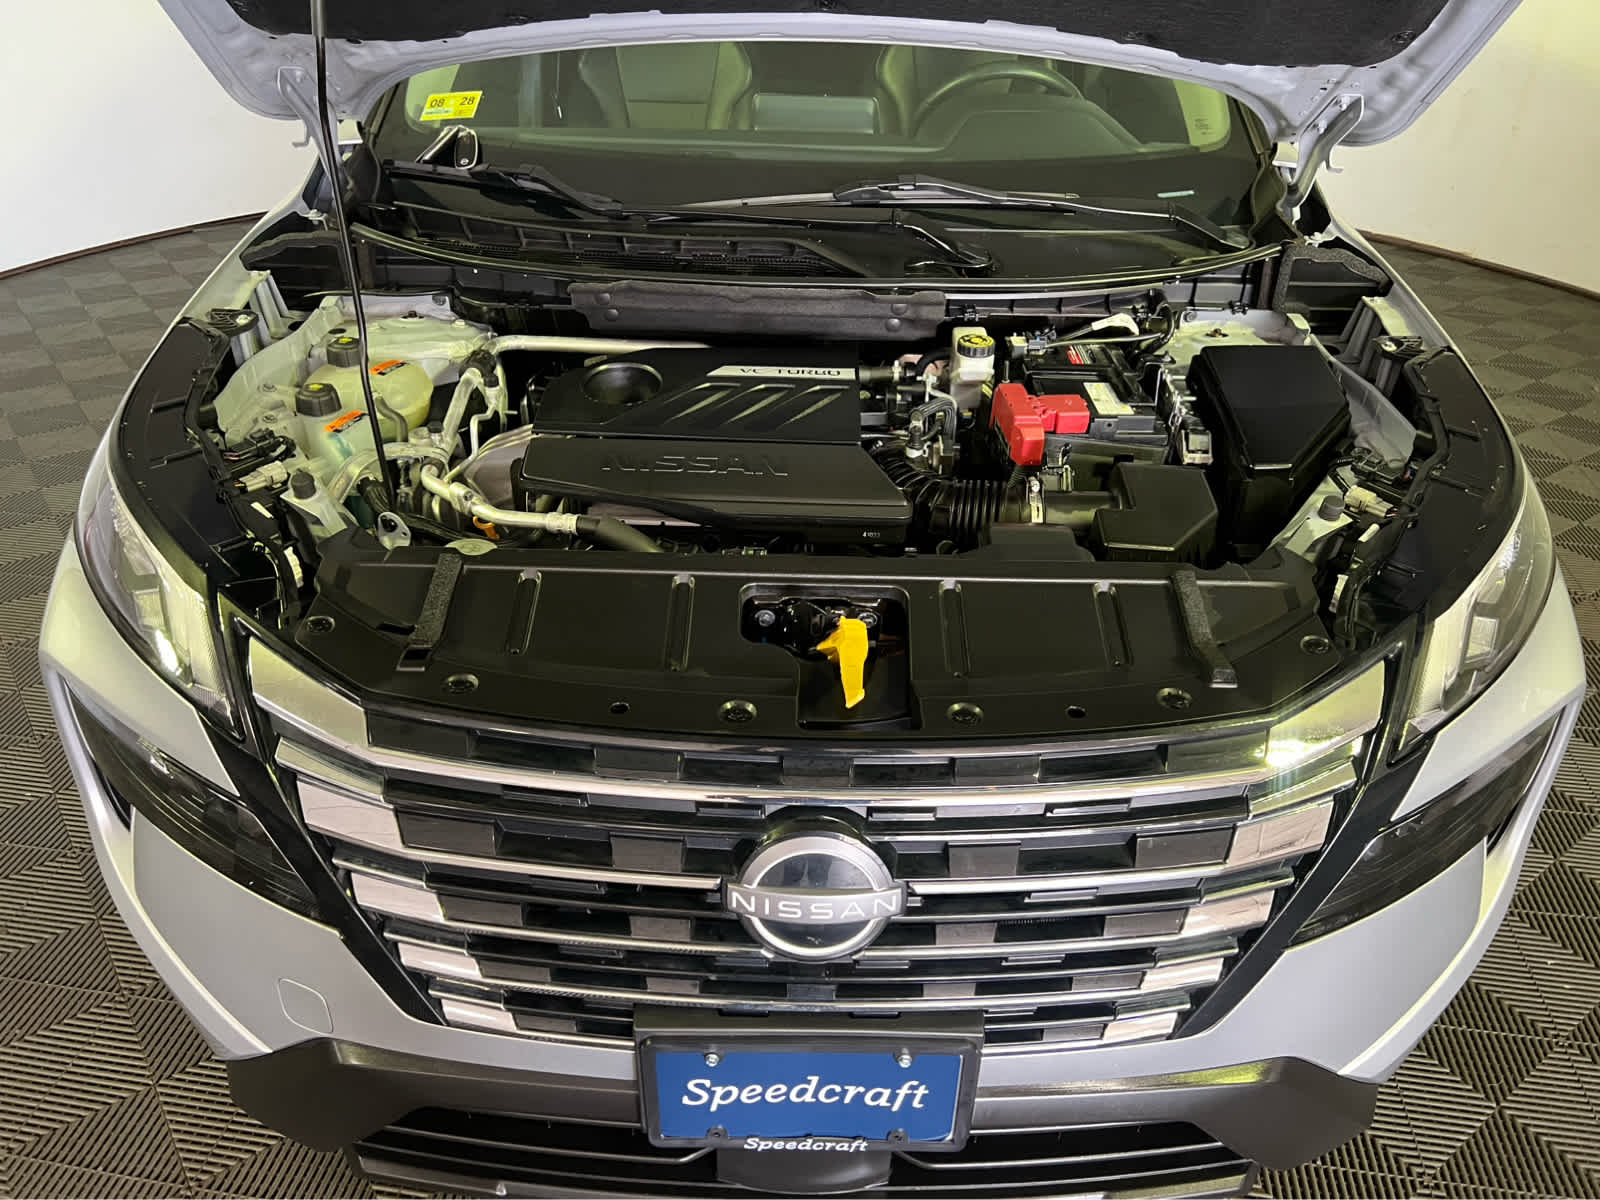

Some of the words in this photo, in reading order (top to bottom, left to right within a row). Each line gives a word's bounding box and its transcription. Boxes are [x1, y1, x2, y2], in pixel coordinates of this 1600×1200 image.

[430, 98, 446, 108] 08
[459, 96, 476, 106] 28
[776, 368, 842, 378] TURBO
[601, 455, 790, 477] NISSAN
[731, 891, 897, 920] NISSAN
[681, 1076, 929, 1112] Speedcraft
[743, 1136, 869, 1153] Speedcraft
